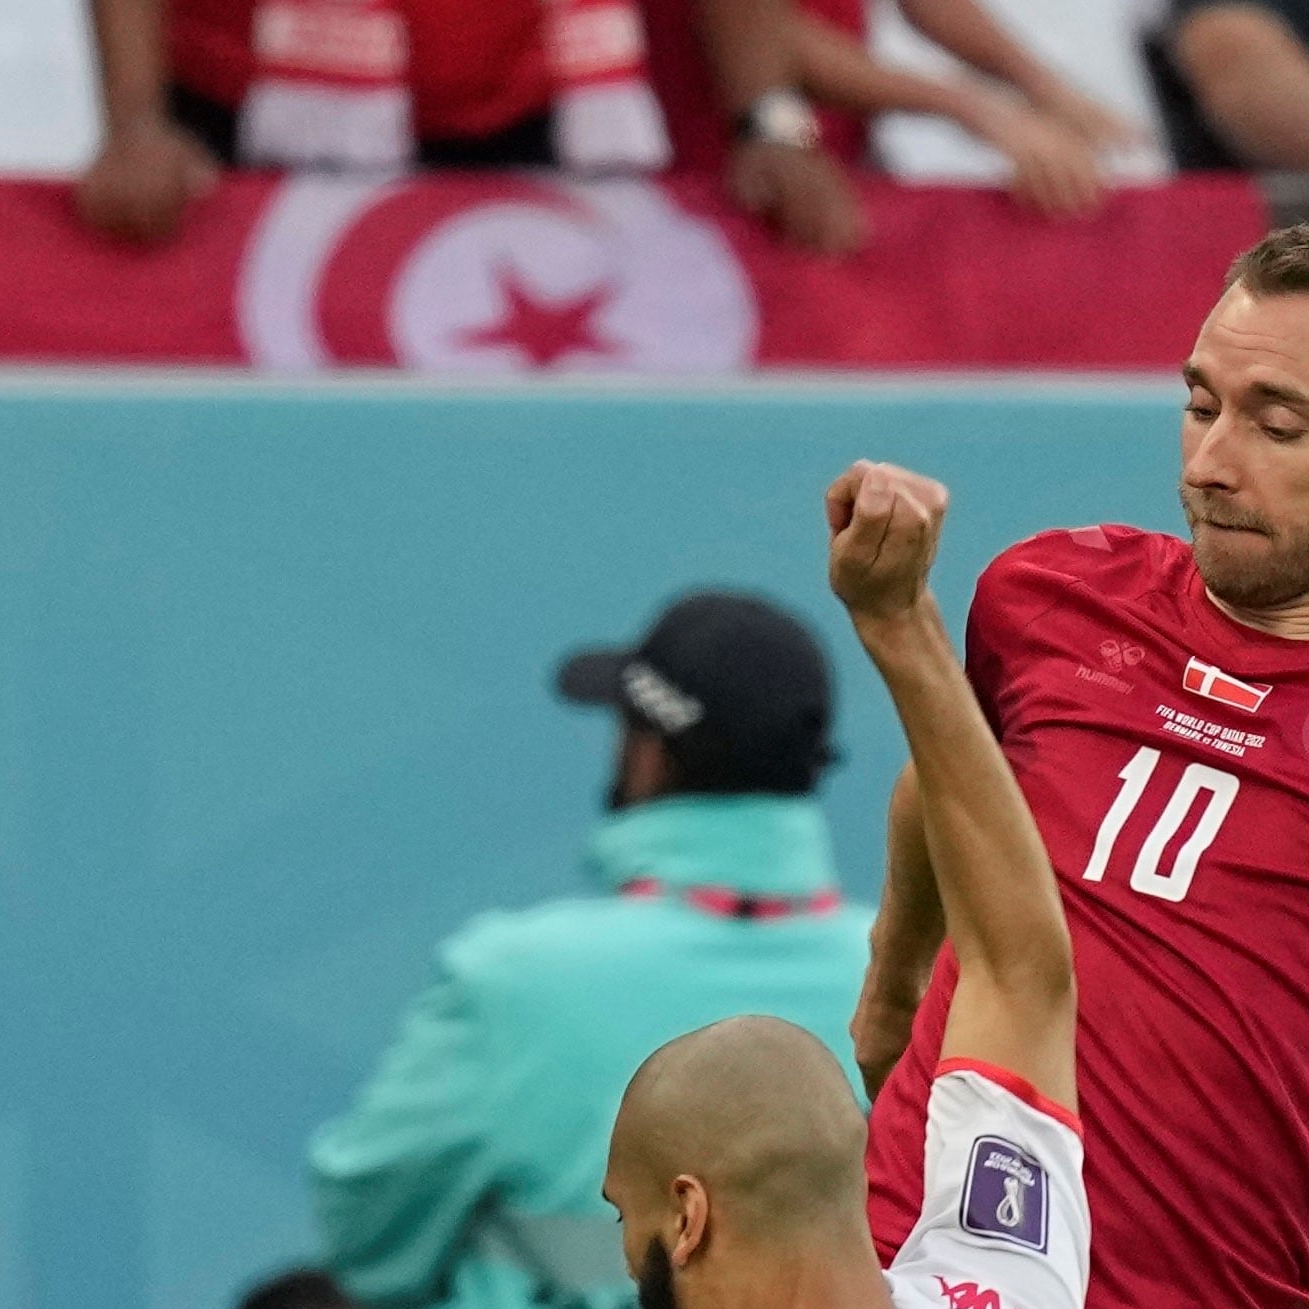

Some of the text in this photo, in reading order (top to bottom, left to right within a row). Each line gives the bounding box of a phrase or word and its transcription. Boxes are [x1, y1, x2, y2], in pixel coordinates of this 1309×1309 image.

[1155, 704, 1177, 720] FIFA
[1175, 712, 1205, 731] WORLD
[1203, 721, 1222, 736] CUP
[1082, 745, 1240, 902] 10
